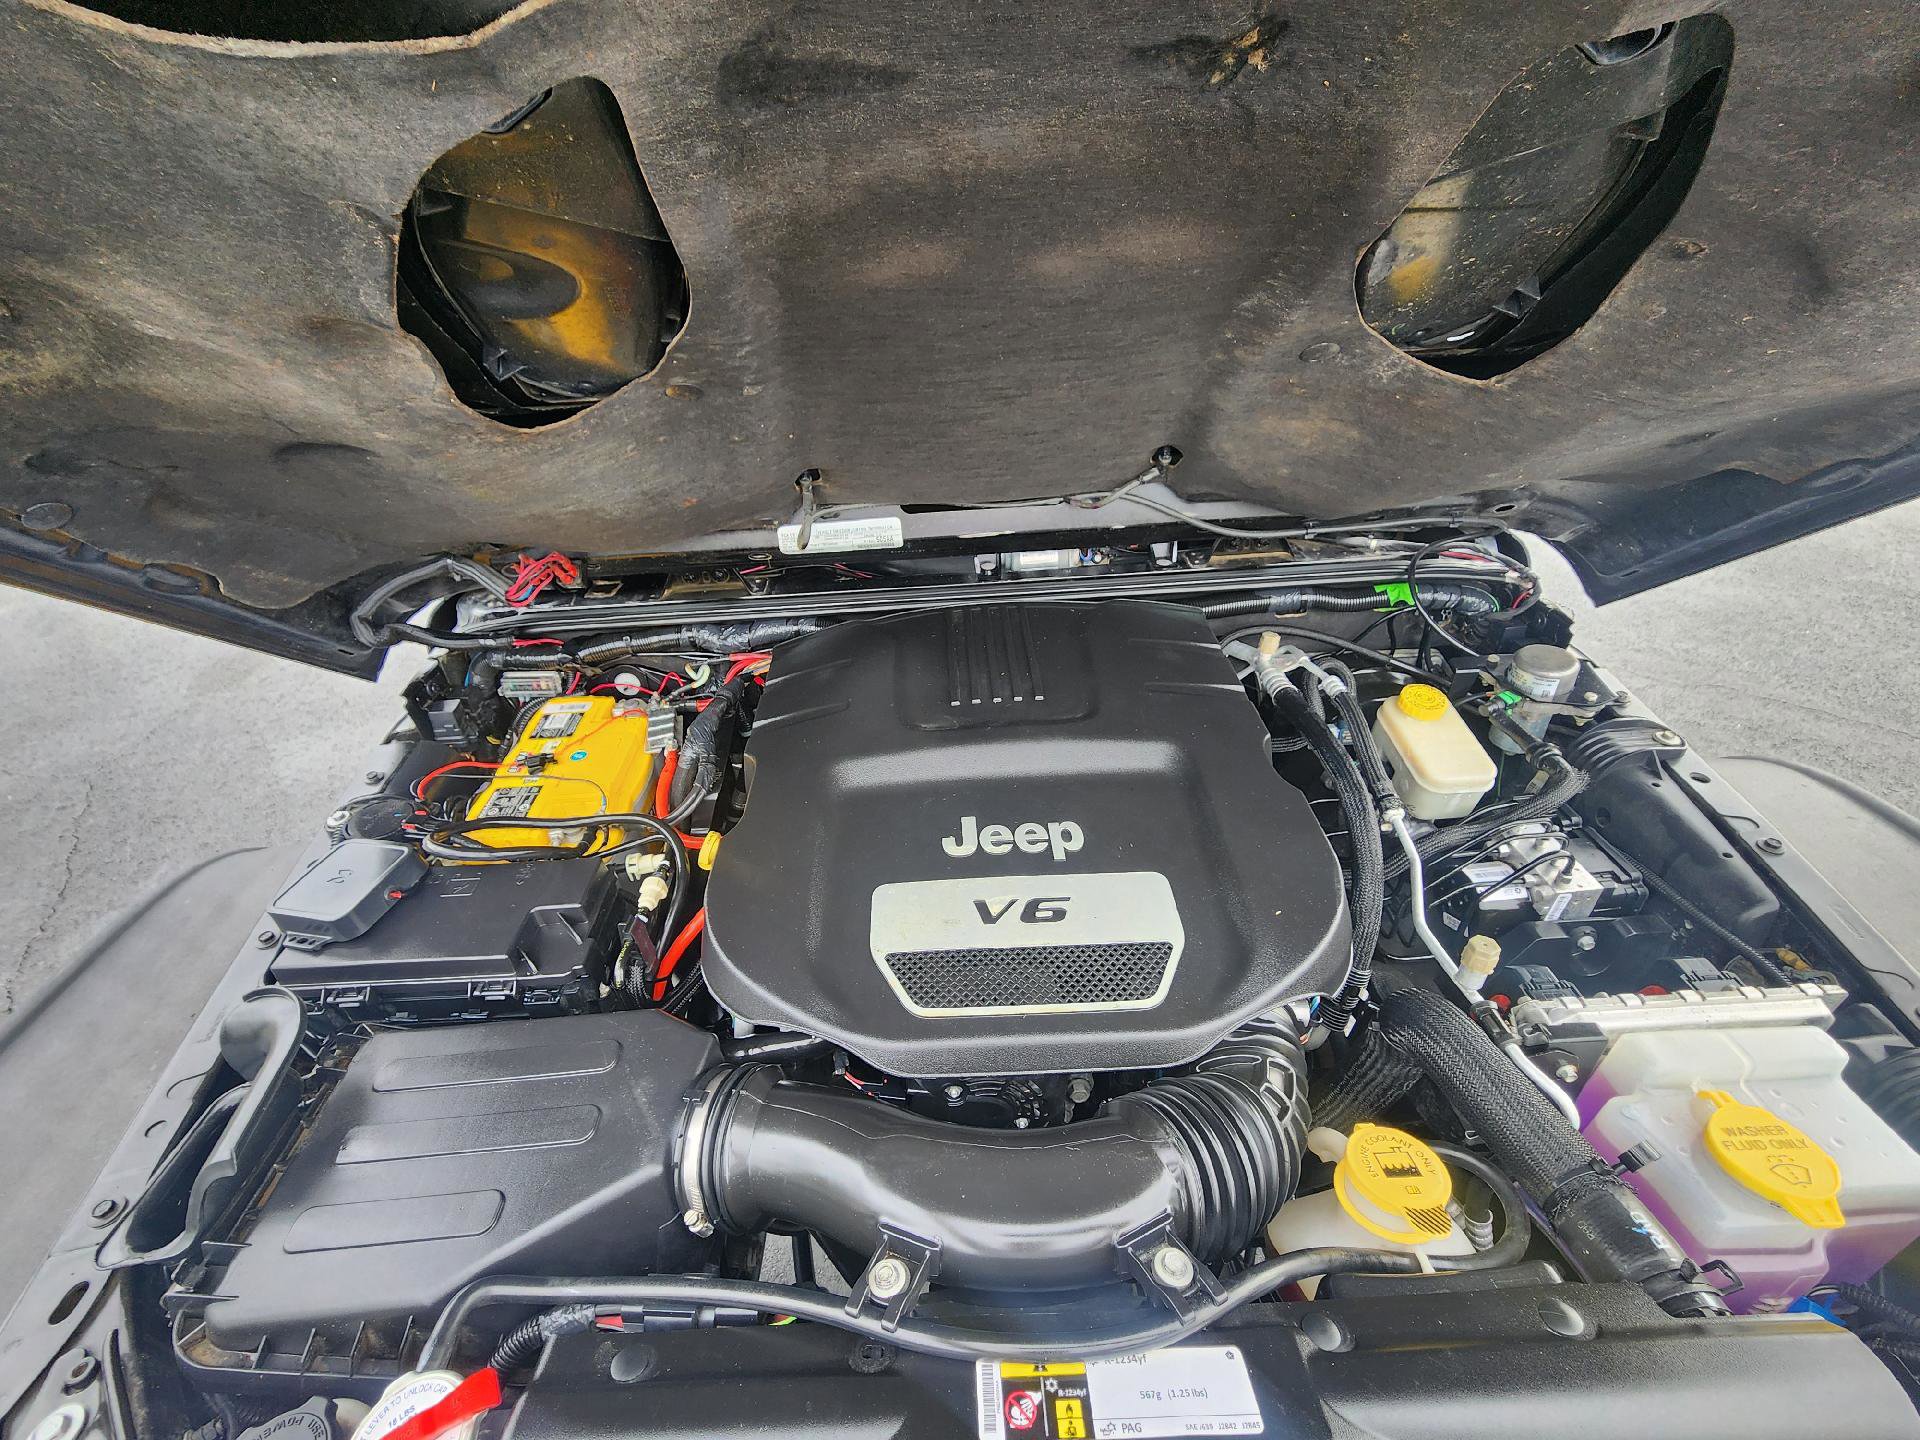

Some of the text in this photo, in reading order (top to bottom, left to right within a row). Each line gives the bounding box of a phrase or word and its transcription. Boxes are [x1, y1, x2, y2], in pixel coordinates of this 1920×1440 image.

[942, 815, 1085, 862] Jeep
[973, 896, 1071, 925] V6
[1721, 1125, 1789, 1138] WASHER
[1721, 1137, 1809, 1151] FLUID ONLY
[1365, 1134, 1413, 1149] COOLANT
[1415, 1150, 1438, 1177] ONLY
[403, 1383, 433, 1400] UNLOCK
[1140, 1387, 1209, 1400] 567g (1.25 lbs)
[1122, 1422, 1142, 1434] PAG
